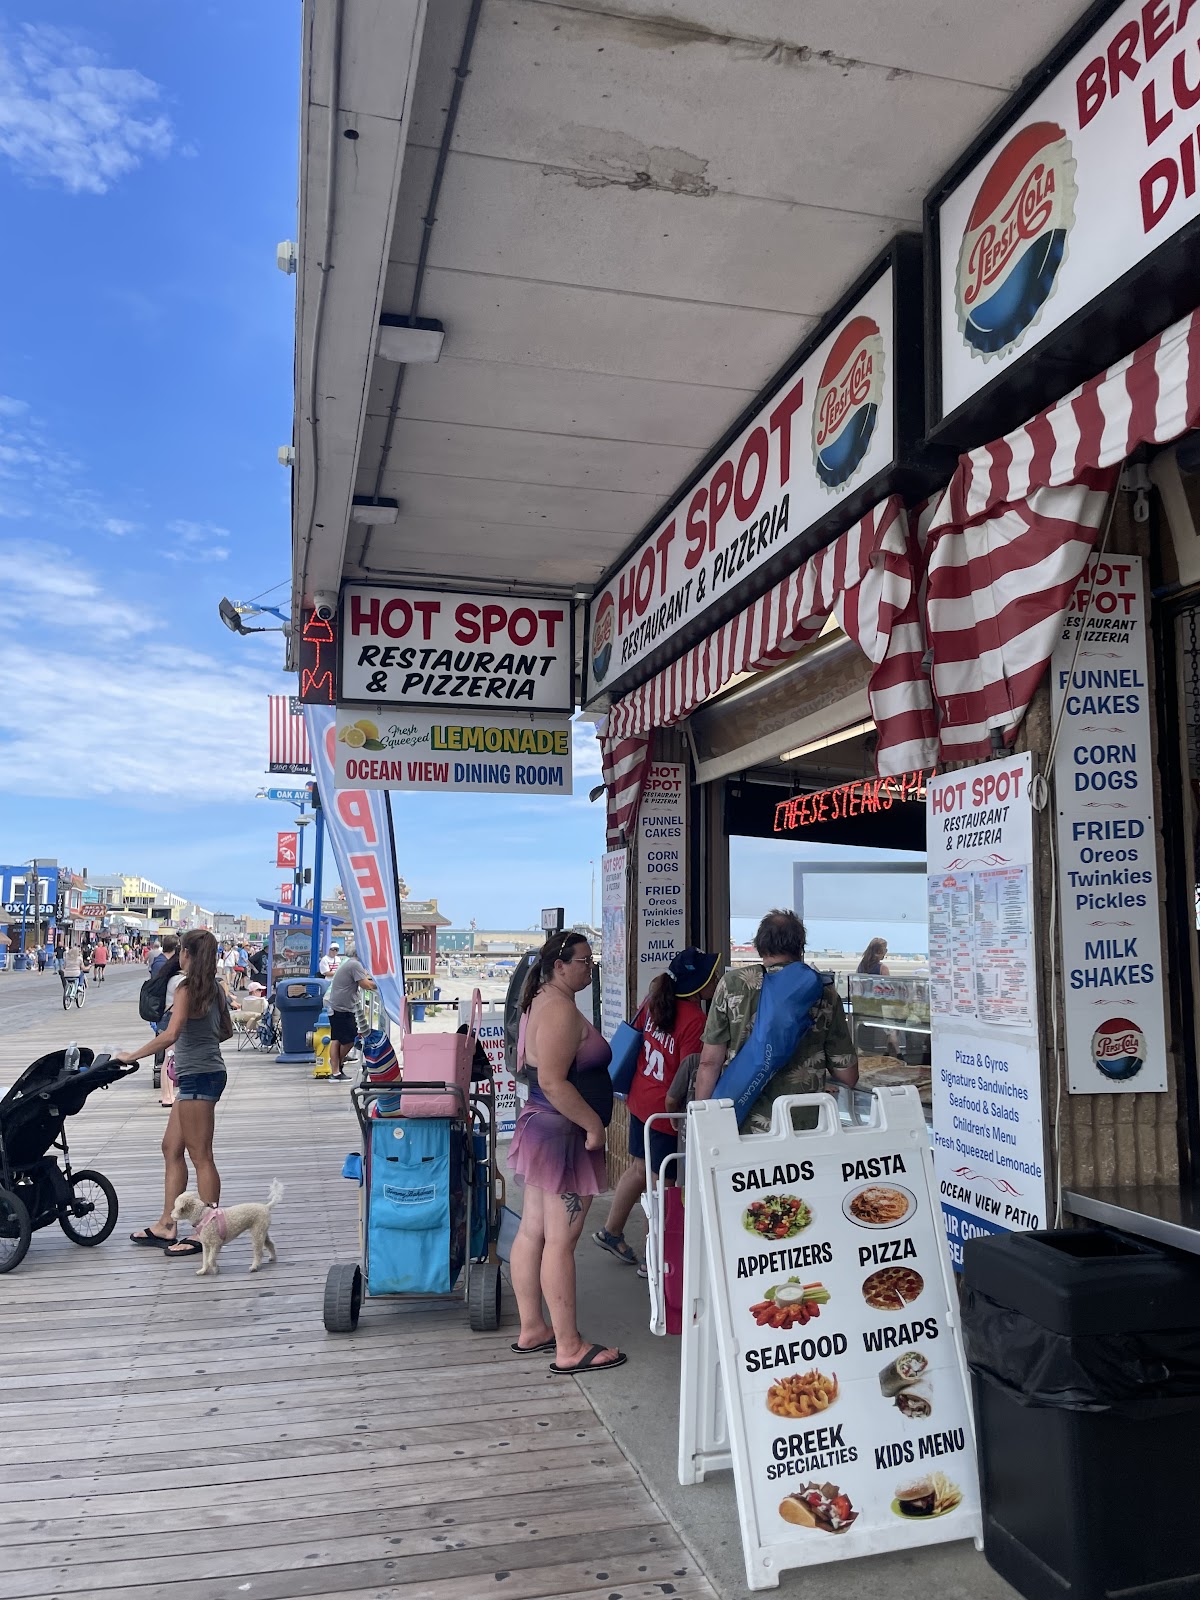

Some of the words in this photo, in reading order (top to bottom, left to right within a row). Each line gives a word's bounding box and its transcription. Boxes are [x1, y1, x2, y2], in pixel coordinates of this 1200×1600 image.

[618, 517, 676, 637] HOT
[684, 377, 803, 570] SPOT
[621, 578, 693, 665] RESTAURANT
[696, 567, 706, 603] &
[712, 493, 790, 591] PIZZERIA
[351, 595, 441, 640] HOT
[454, 602, 564, 648] SPOT
[1062, 629, 1070, 640] &
[303, 608, 334, 700] ATM
[357, 645, 557, 677] RESTAURANT
[366, 671, 388, 692] &
[401, 672, 536, 700] PIZZERIA
[1059, 669, 1145, 690] FUNNEL
[1066, 694, 1140, 716] CAKES
[379, 732, 430, 750] Squeezed
[431, 725, 569, 756] LEMONADE
[388, 724, 418, 738] Fresh
[1073, 744, 1136, 766] CORN
[346, 759, 402, 781] OCEAN
[407, 761, 449, 783] VIEW
[454, 762, 511, 784] DINING
[515, 765, 564, 787] ROOM
[644, 779, 682, 792] SPOT
[650, 767, 680, 779] HOT
[1075, 770, 1138, 792] DOGS
[277, 790, 293, 799] OAK
[294, 791, 309, 800] AVE
[932, 781, 967, 816] HOT
[972, 767, 1024, 808] SPOT
[642, 816, 684, 826] FUNNEL
[943, 806, 1010, 833] RESTAURANT
[1072, 819, 1144, 842] FRIED
[645, 828, 681, 838] CAKES
[946, 836, 953, 851] &
[957, 827, 1002, 849] PIZZERIA
[647, 851, 679, 861] CORN
[647, 863, 679, 873] DOGS
[1080, 847, 1138, 864] Oreos
[645, 885, 681, 896] FRIED
[1067, 868, 1153, 888] Twinkies
[642, 907, 684, 917] Twinkies
[648, 898, 677, 906] Oreos
[1076, 892, 1147, 911] Pickles
[645, 918, 680, 927] Pickles
[648, 939, 674, 949] MILK
[1085, 937, 1138, 961] MILK
[1070, 963, 1154, 989] SHAKES
[955, 1050, 975, 1067] Pizza
[976, 1053, 983, 1067] &
[984, 1055, 1009, 1073] Gyros
[940, 1069, 976, 1088] Signature
[977, 1076, 1029, 1100] Sandwiches
[949, 1093, 981, 1114] Seafood
[982, 1101, 989, 1115] &
[991, 1102, 1020, 1123] Salads
[953, 1116, 991, 1138] Children's
[993, 1126, 1017, 1146] Menu
[841, 1153, 906, 1182] PASTA
[935, 1132, 955, 1151] Fresh
[956, 1139, 994, 1164] Squeezed
[996, 1150, 1042, 1178] Lemonade
[731, 1160, 815, 1193] SALADS
[940, 1179, 972, 1205] OCEAN
[975, 1194, 1001, 1216] VIEW
[1005, 1204, 1039, 1230] PATIO
[737, 1242, 833, 1279] APPETIZERS
[858, 1237, 918, 1267] PIZZA
[863, 1317, 939, 1353] WRAPS
[745, 1332, 848, 1373] SEAFOOD
[772, 1424, 846, 1462] GREEK
[875, 1442, 916, 1471] KIDS
[918, 1427, 966, 1460] MENU
[766, 1446, 859, 1480] SPECIALTIES
